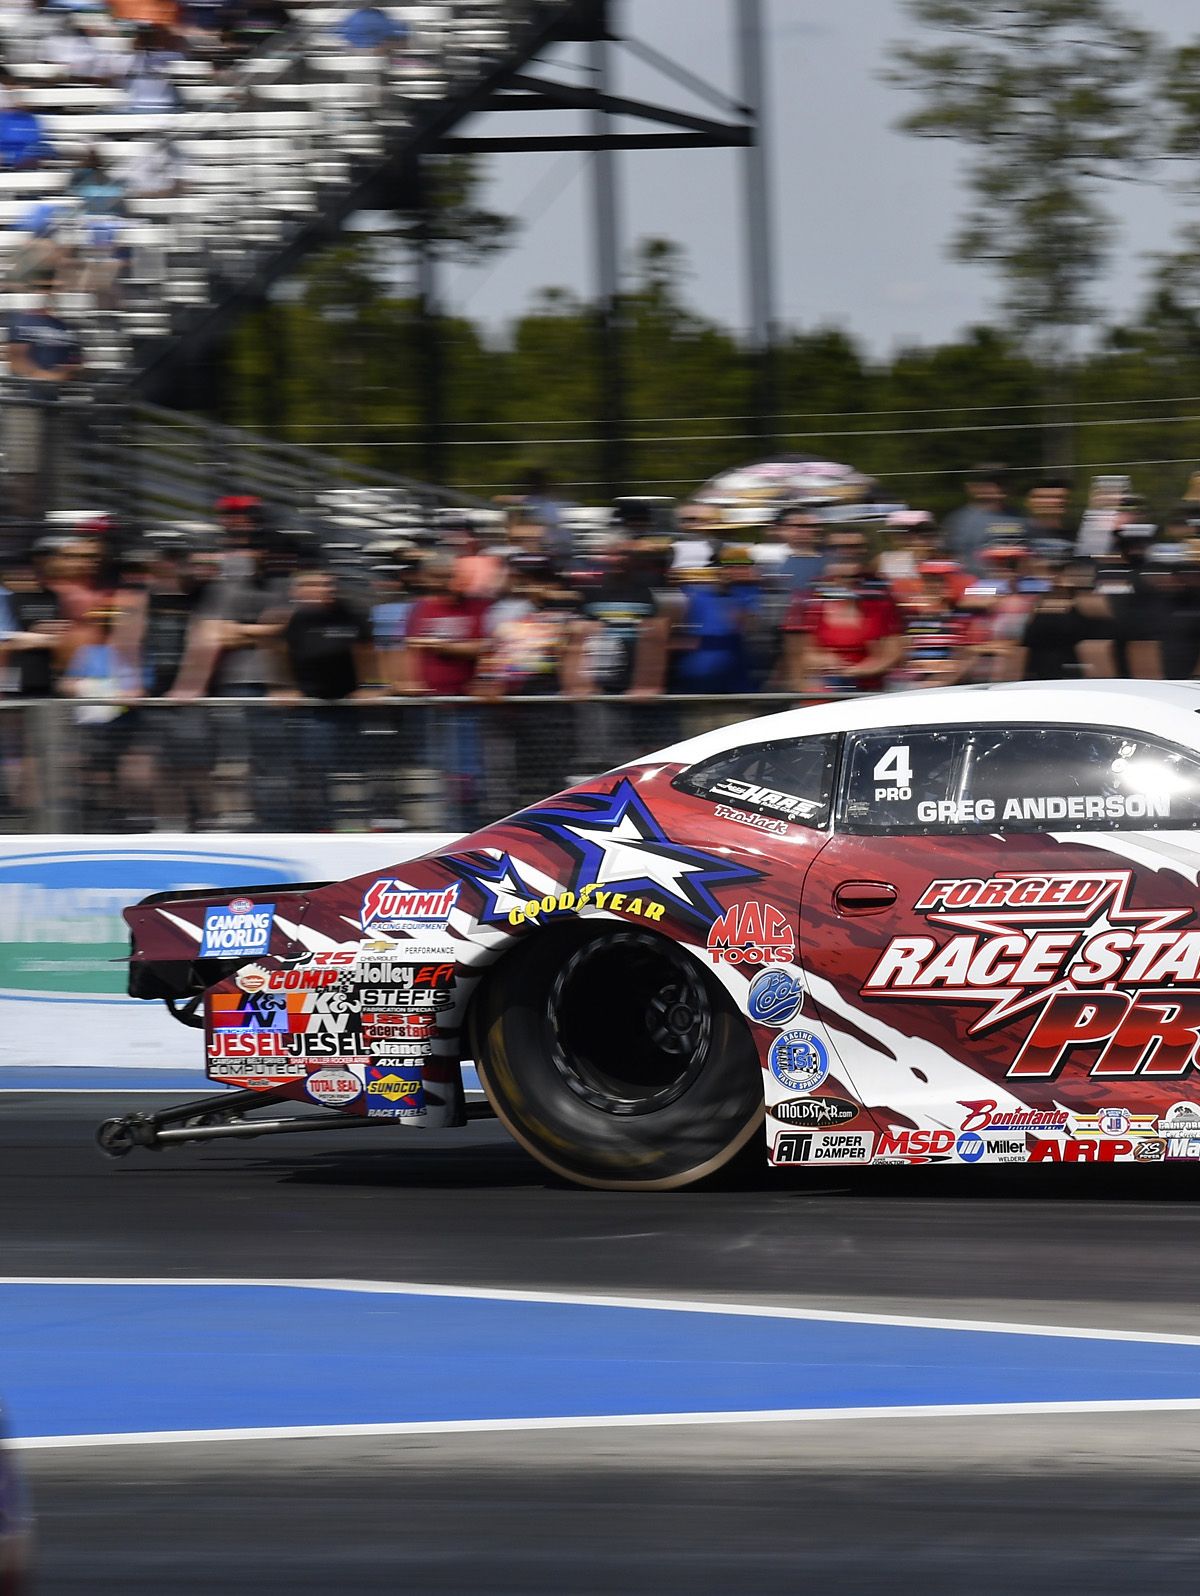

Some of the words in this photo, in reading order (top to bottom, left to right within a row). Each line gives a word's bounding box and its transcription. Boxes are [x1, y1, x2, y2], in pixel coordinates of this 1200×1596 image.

[874, 745, 913, 787] 4
[875, 787, 912, 801] PRO
[917, 800, 996, 823] GREG
[1003, 794, 1171, 820] ANDERSON
[914, 877, 1101, 911] FORGED
[206, 913, 270, 930] CAMPING
[707, 902, 795, 947] MAC
[205, 928, 268, 949] WORLD
[708, 947, 795, 965] TOOLS
[867, 932, 1079, 988] RACE
[268, 970, 338, 989] COMP
[355, 962, 413, 988] Holley
[415, 964, 455, 987] EFI
[301, 992, 362, 1013] K&
[364, 990, 451, 1005] STEF'S
[305, 1013, 349, 1033] N
[208, 1033, 284, 1056] JESEL
[288, 1033, 371, 1056] JESEL
[783, 1031, 813, 1042] RACING
[371, 1040, 432, 1055] Strange
[209, 1065, 306, 1075] COMPUTECH
[376, 1058, 424, 1066] AXLES
[309, 1080, 335, 1092] TOTAL
[337, 1080, 358, 1092] SEAL
[369, 1082, 417, 1093] SUNOCO
[778, 1072, 798, 1089] VALVE
[799, 1070, 824, 1090] SPRINGS
[368, 1109, 392, 1117] RACE
[394, 1108, 427, 1117] FUELS
[956, 1099, 1070, 1131] Boninfante
[776, 1134, 812, 1161] ATI
[822, 1136, 863, 1147] SUPER
[876, 1130, 956, 1155] MSD
[987, 1140, 1024, 1153] Miller
[1027, 1140, 1133, 1162] ARP
[1138, 1142, 1161, 1154] XS
[815, 1148, 866, 1159] DAMPER
